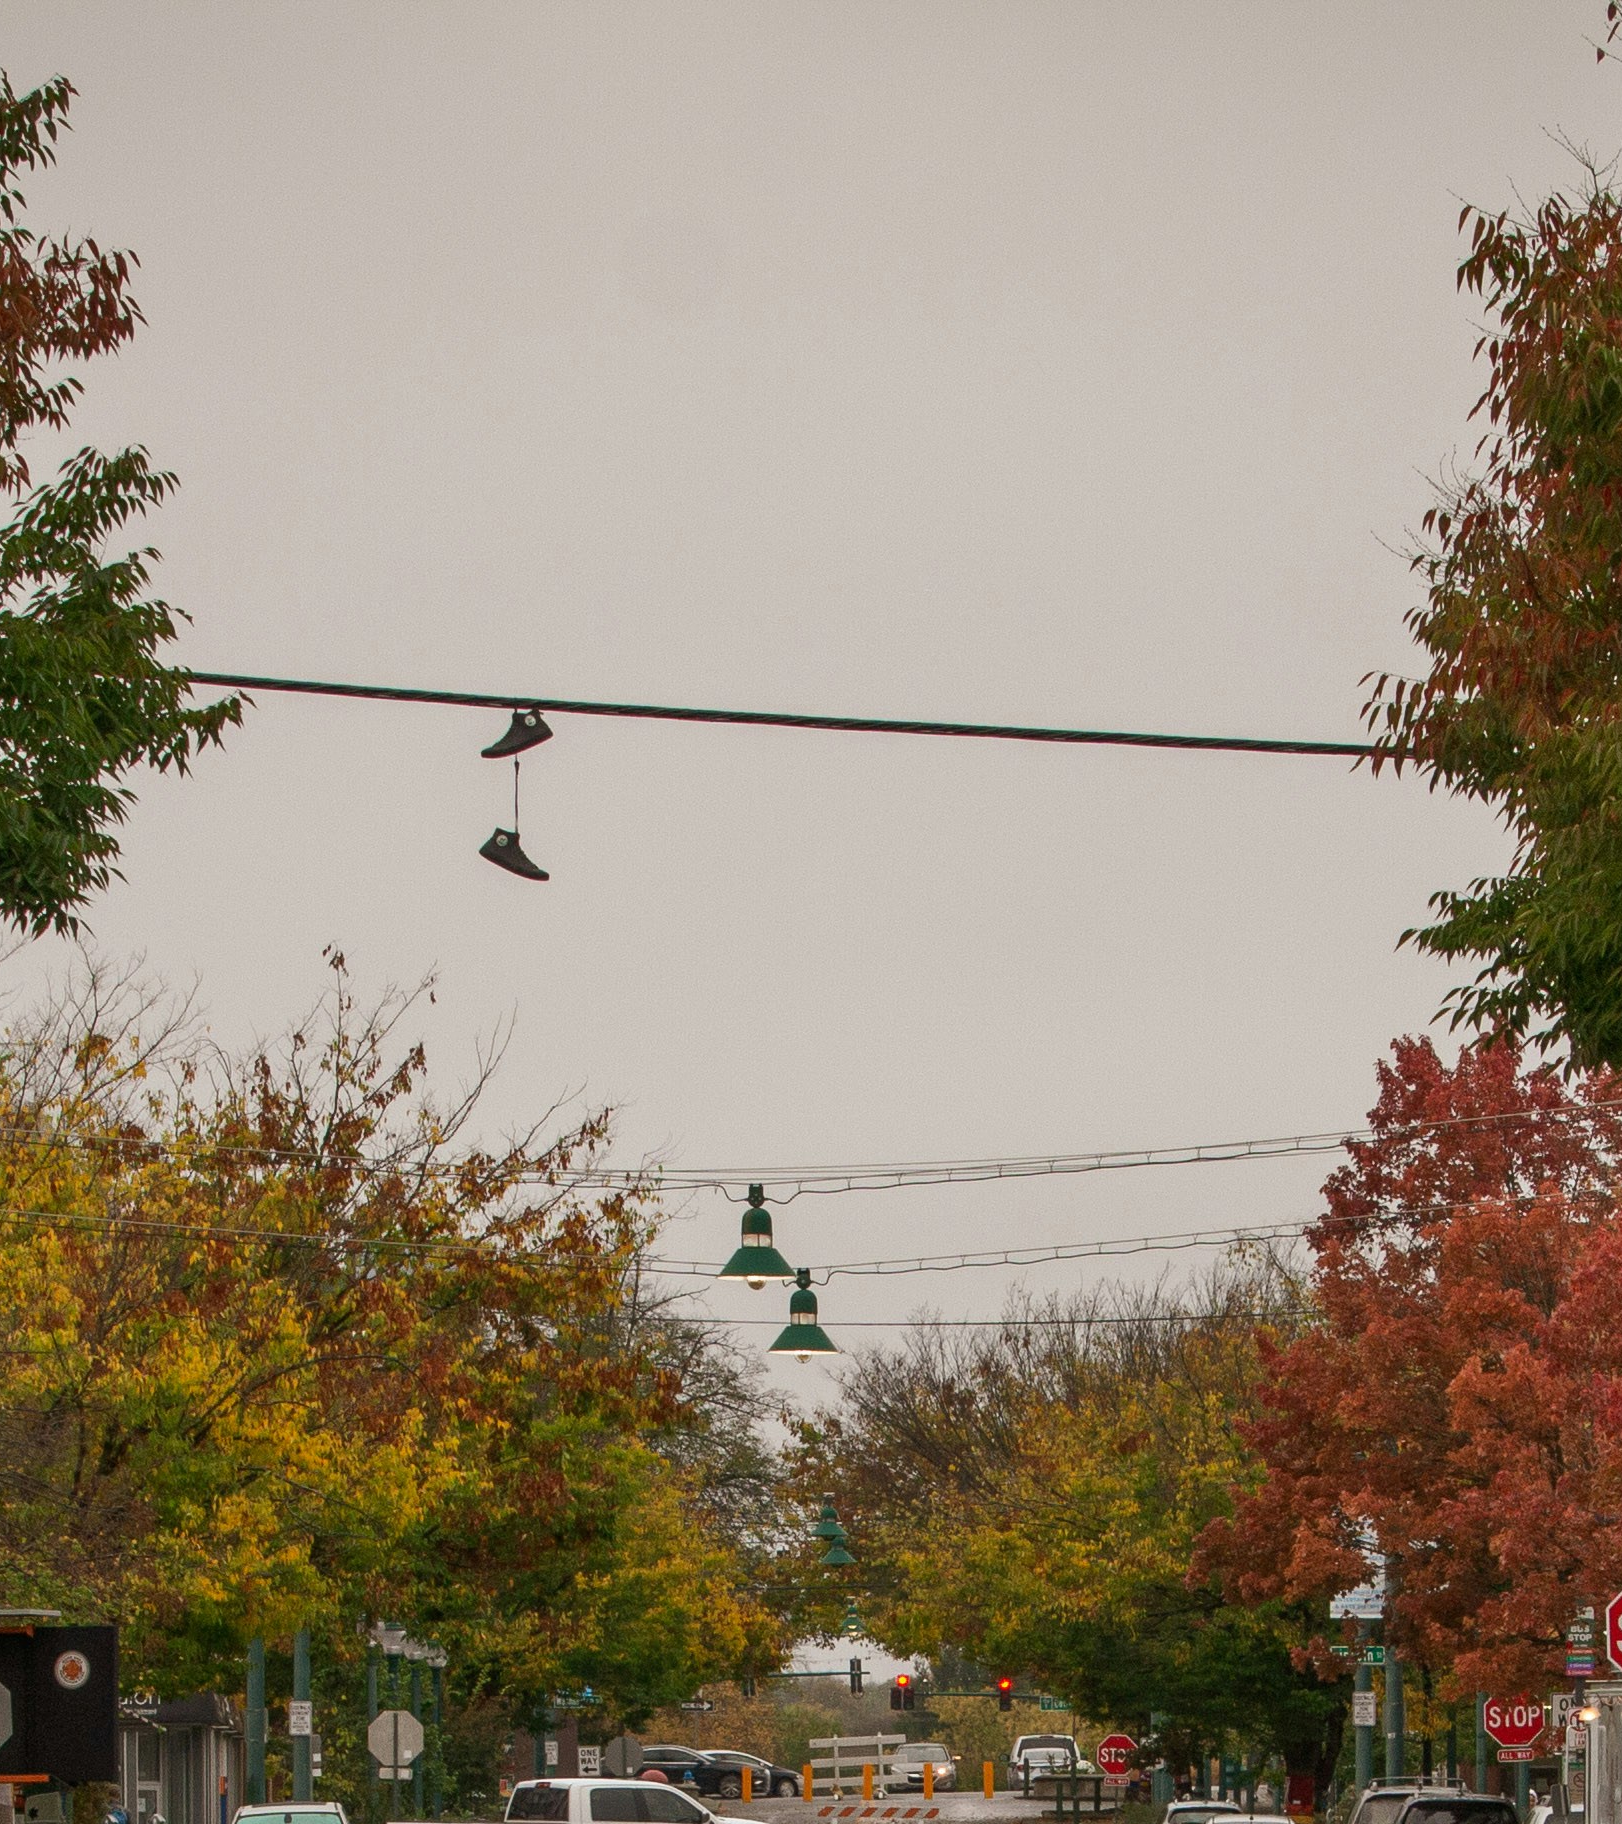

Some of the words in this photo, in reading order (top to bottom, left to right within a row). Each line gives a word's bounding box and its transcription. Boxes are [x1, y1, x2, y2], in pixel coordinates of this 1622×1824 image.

[1568, 1634, 1593, 1642] STOP
[1488, 1706, 1541, 1728] STOP
[580, 1749, 598, 1757] ONE
[1500, 1751, 1513, 1761] ALL
[1517, 1751, 1531, 1761] WAY
[580, 1757, 598, 1765] WAY
